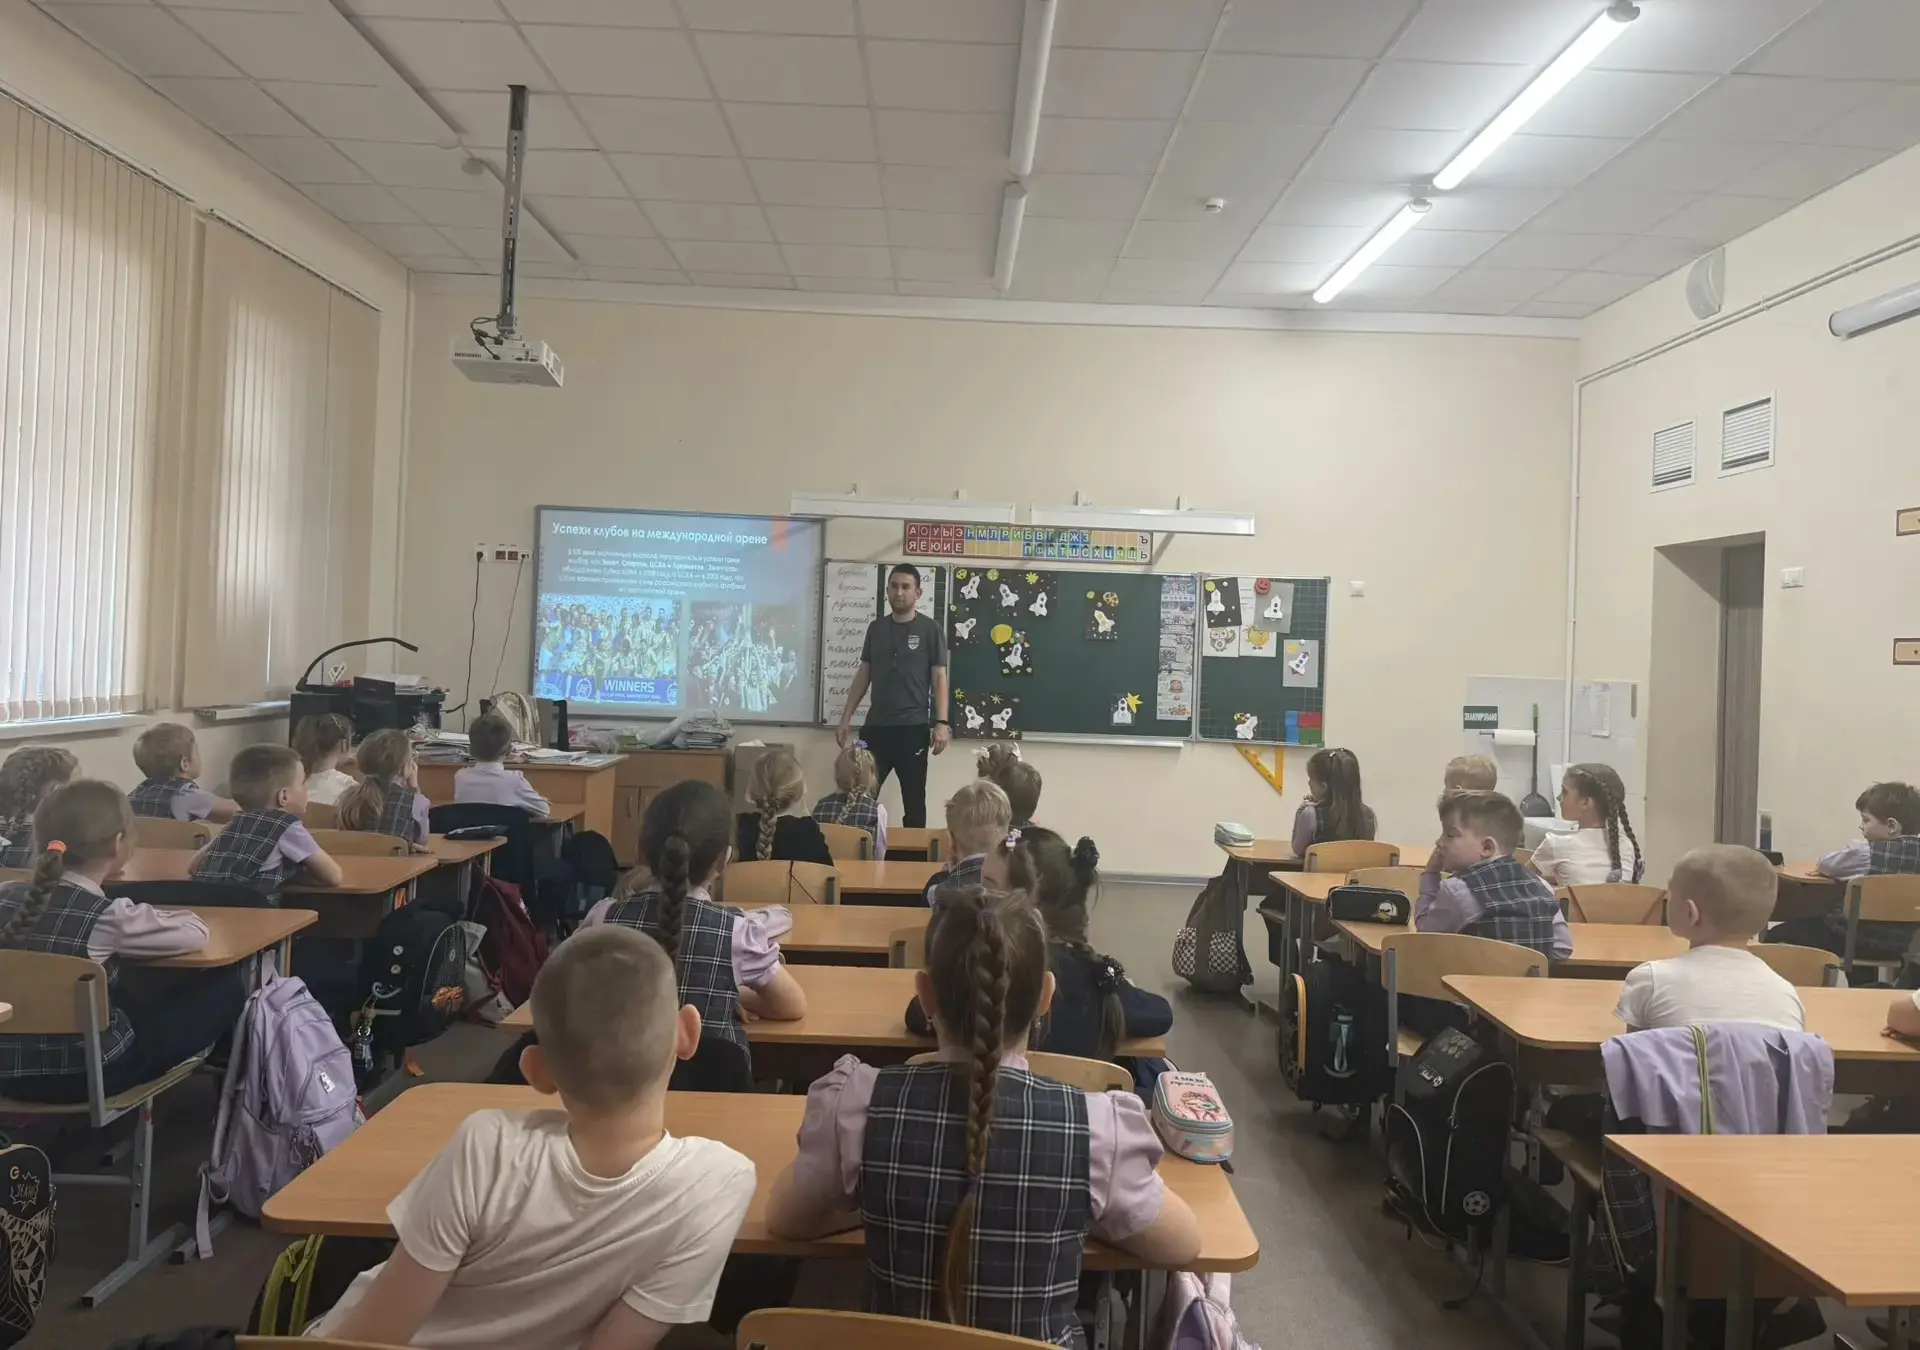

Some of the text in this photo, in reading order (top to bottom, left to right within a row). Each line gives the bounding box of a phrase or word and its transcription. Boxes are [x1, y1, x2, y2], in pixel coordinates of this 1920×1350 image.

[553, 522, 768, 547] Успехи клубов на международной арене
[603, 679, 656, 693] WINNERS
